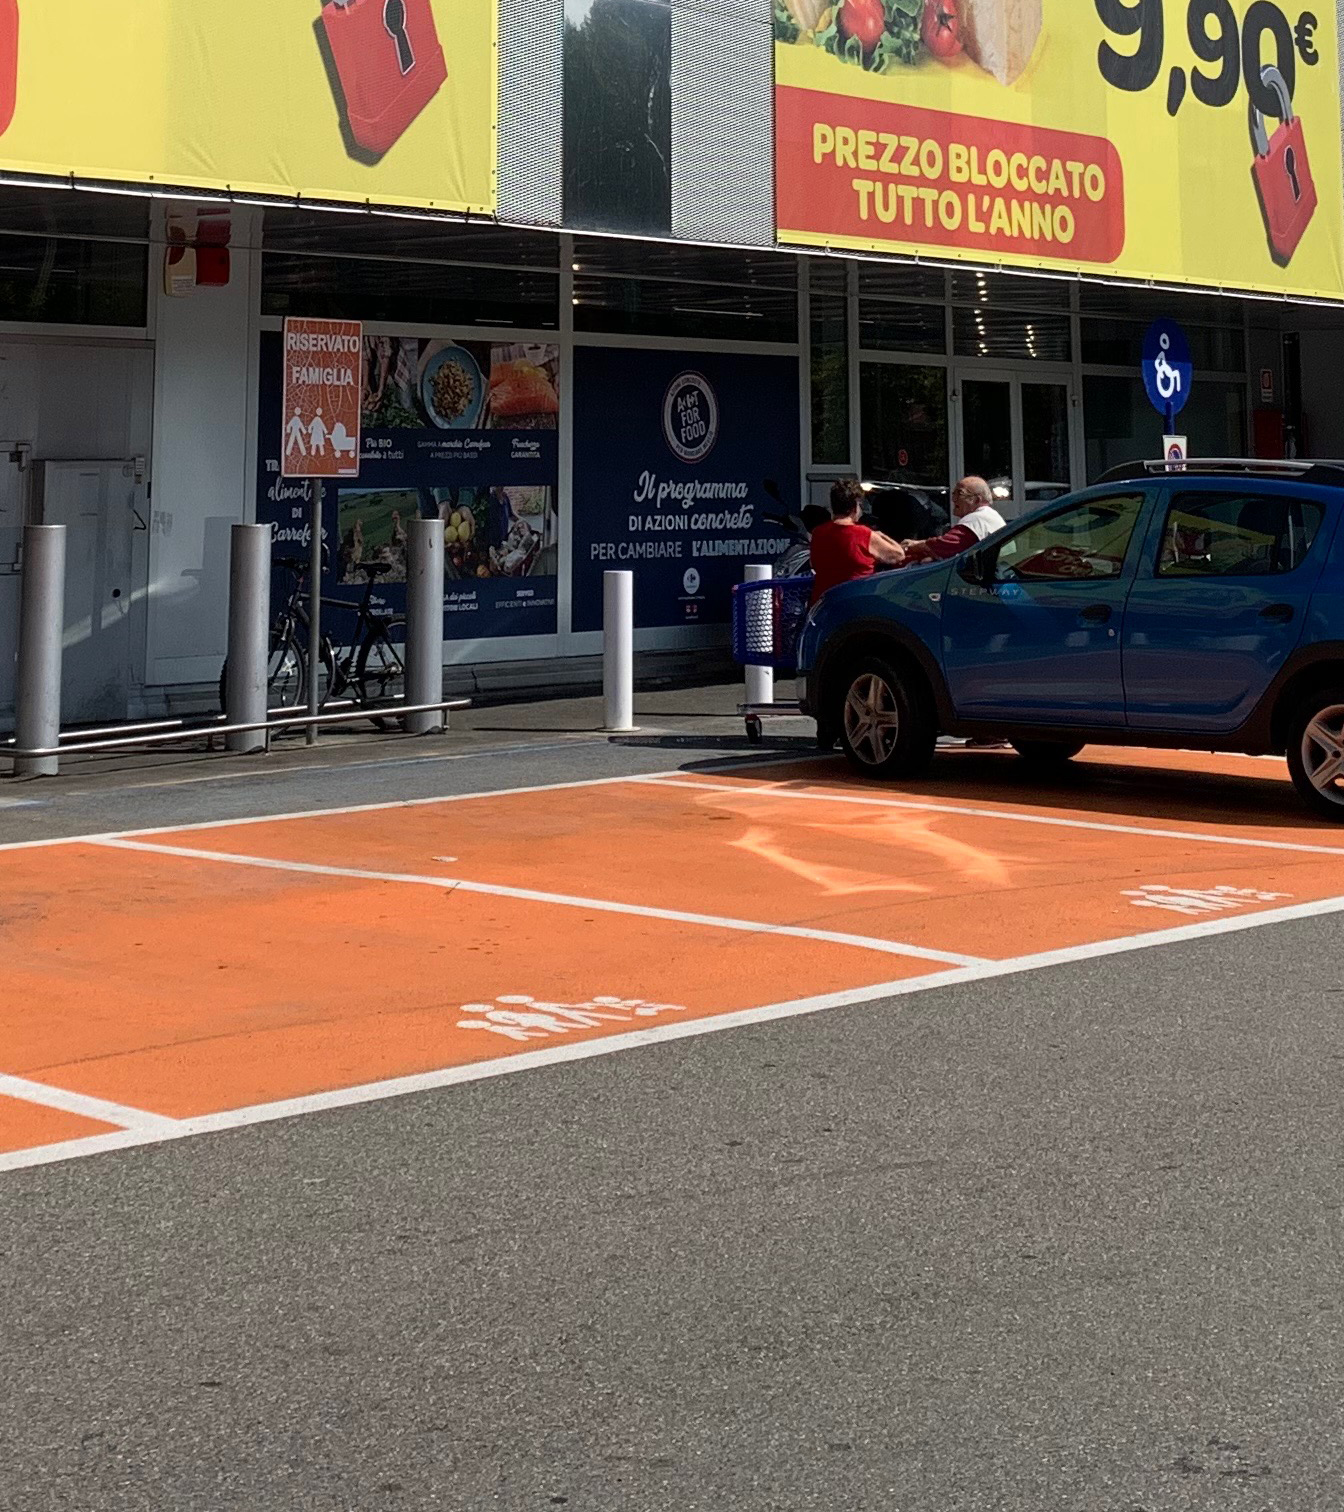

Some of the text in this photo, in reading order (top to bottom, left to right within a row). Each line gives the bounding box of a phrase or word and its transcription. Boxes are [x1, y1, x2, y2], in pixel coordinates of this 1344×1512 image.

[812, 123, 1105, 202] PREZZO BLOCCATO
[852, 179, 1075, 244] TUTTO L'ANNO
[287, 332, 359, 352] RISERVATO
[292, 367, 353, 385] FAMIGLIA
[681, 407, 701, 427] FOR
[680, 420, 706, 443] FOOD
[634, 470, 748, 509] Il programma
[292, 507, 302, 519] DI
[628, 504, 754, 531] DI AZIONI concrete
[590, 543, 616, 560] PER
[618, 541, 682, 559] CAMBIARE
